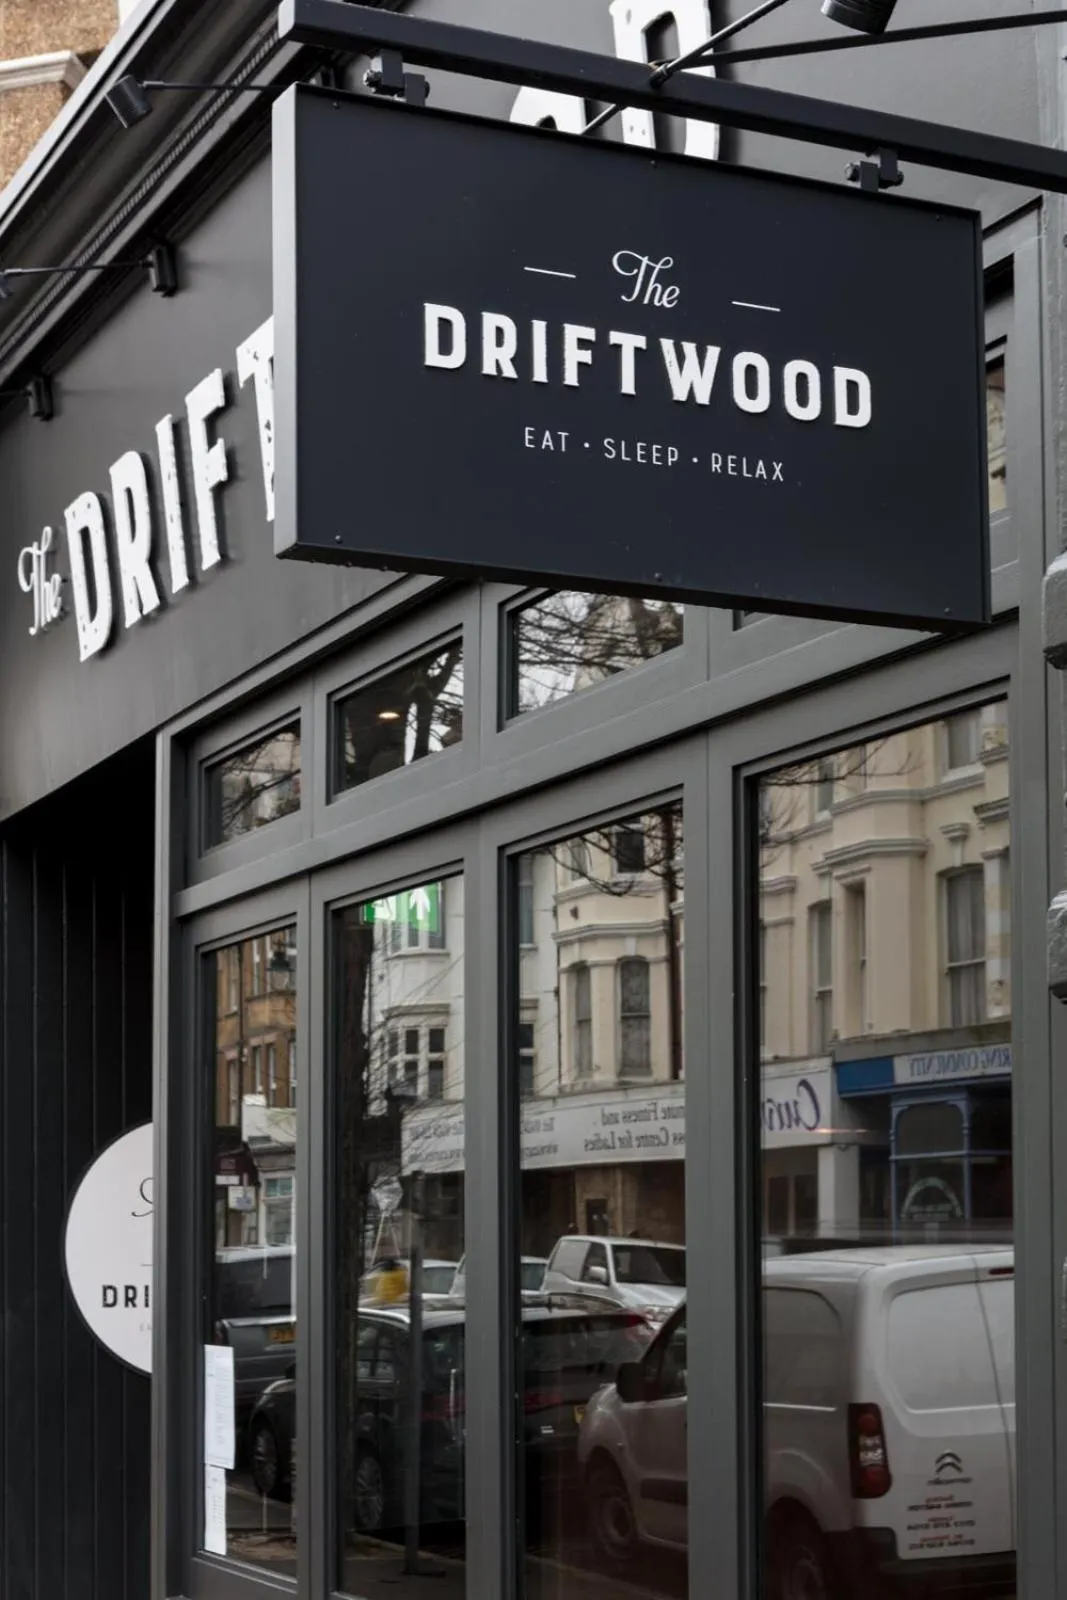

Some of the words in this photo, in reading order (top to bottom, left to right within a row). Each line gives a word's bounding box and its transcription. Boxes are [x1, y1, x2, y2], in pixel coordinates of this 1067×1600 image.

[612, 250, 680, 308] The
[423, 302, 872, 429] DRIFTWOOD
[525, 427, 569, 452] EAT
[603, 438, 679, 467] SLEEP
[711, 453, 784, 482] RELAX
[18, 526, 62, 636] The
